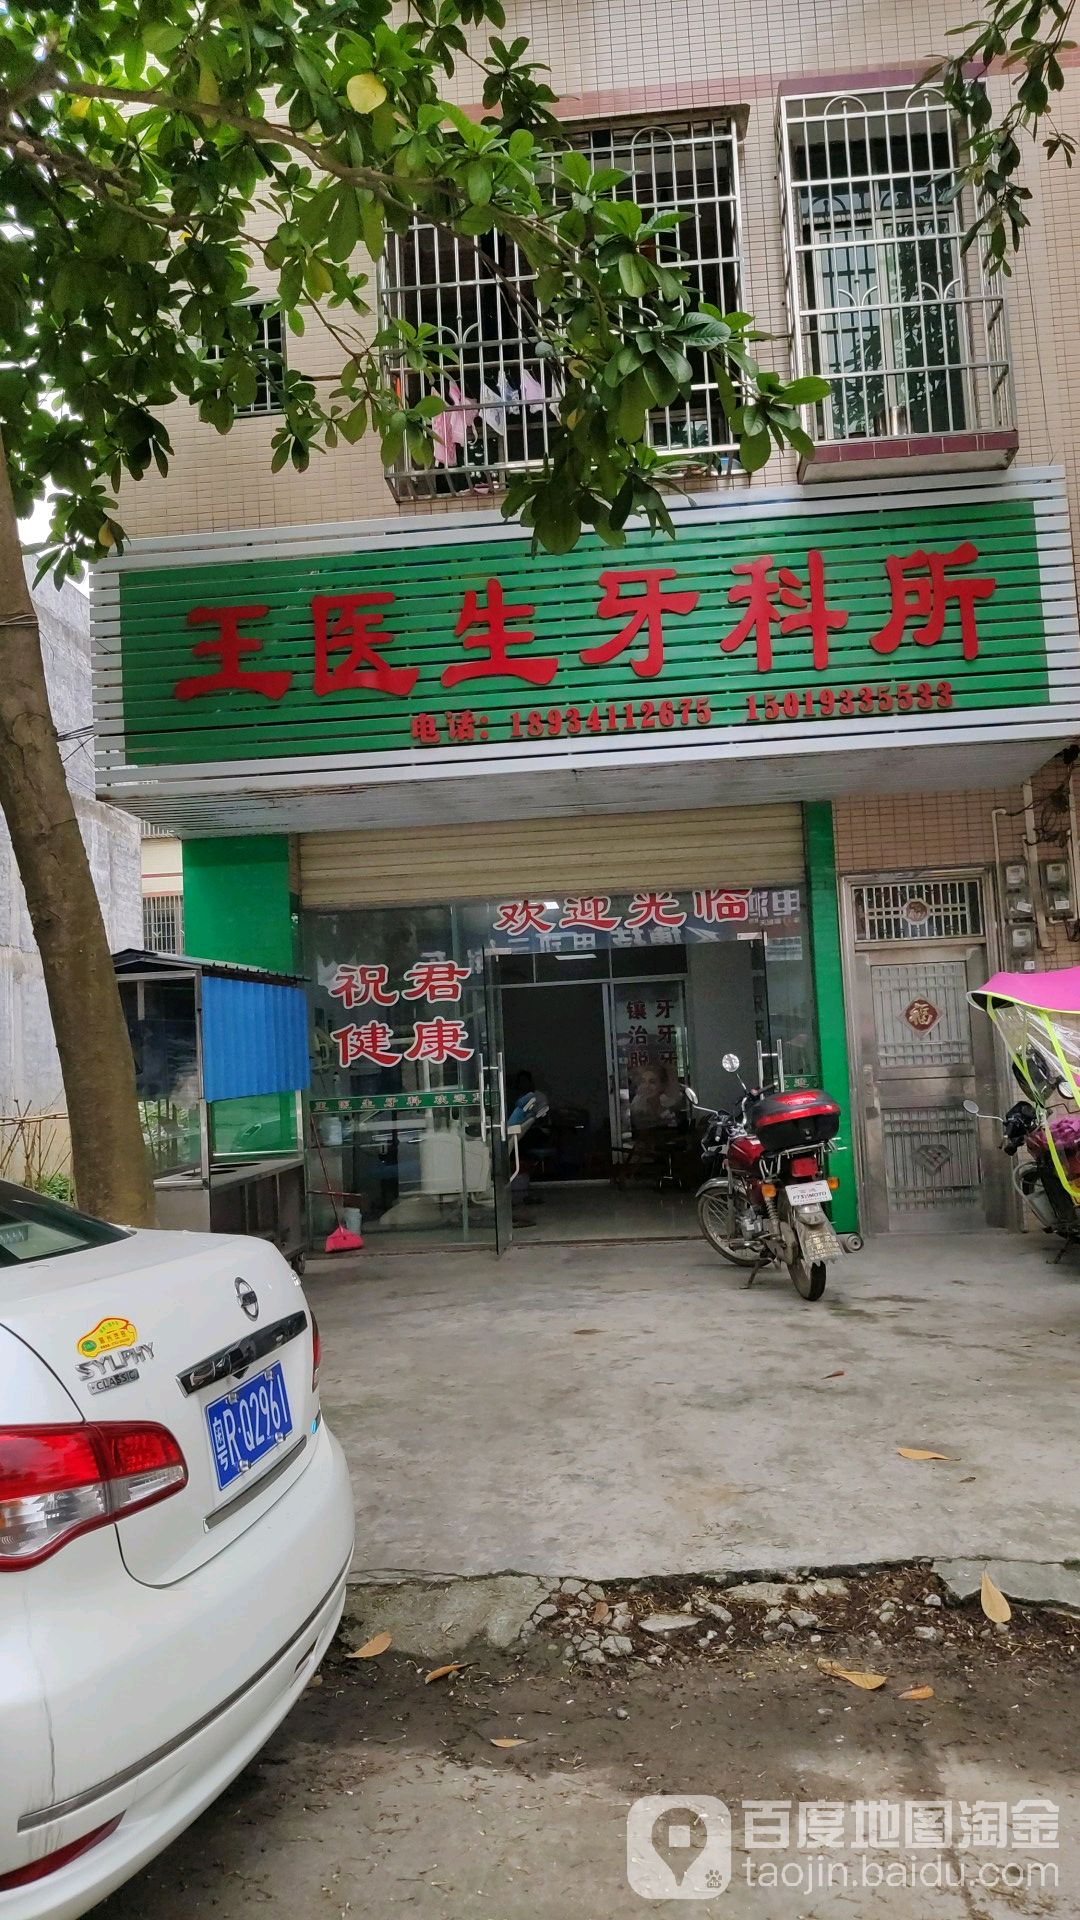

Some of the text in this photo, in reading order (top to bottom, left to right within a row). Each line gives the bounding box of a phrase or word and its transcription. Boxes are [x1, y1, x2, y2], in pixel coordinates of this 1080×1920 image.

[174, 542, 996, 701] 王医生牙科所
[511, 697, 712, 738] 18934112675
[746, 681, 953, 721] 15019335533
[493, 888, 752, 936] 欢迎光临
[328, 960, 472, 1009] 祝君
[330, 1016, 475, 1068] 健康
[75, 1341, 155, 1381] SYLPHY
